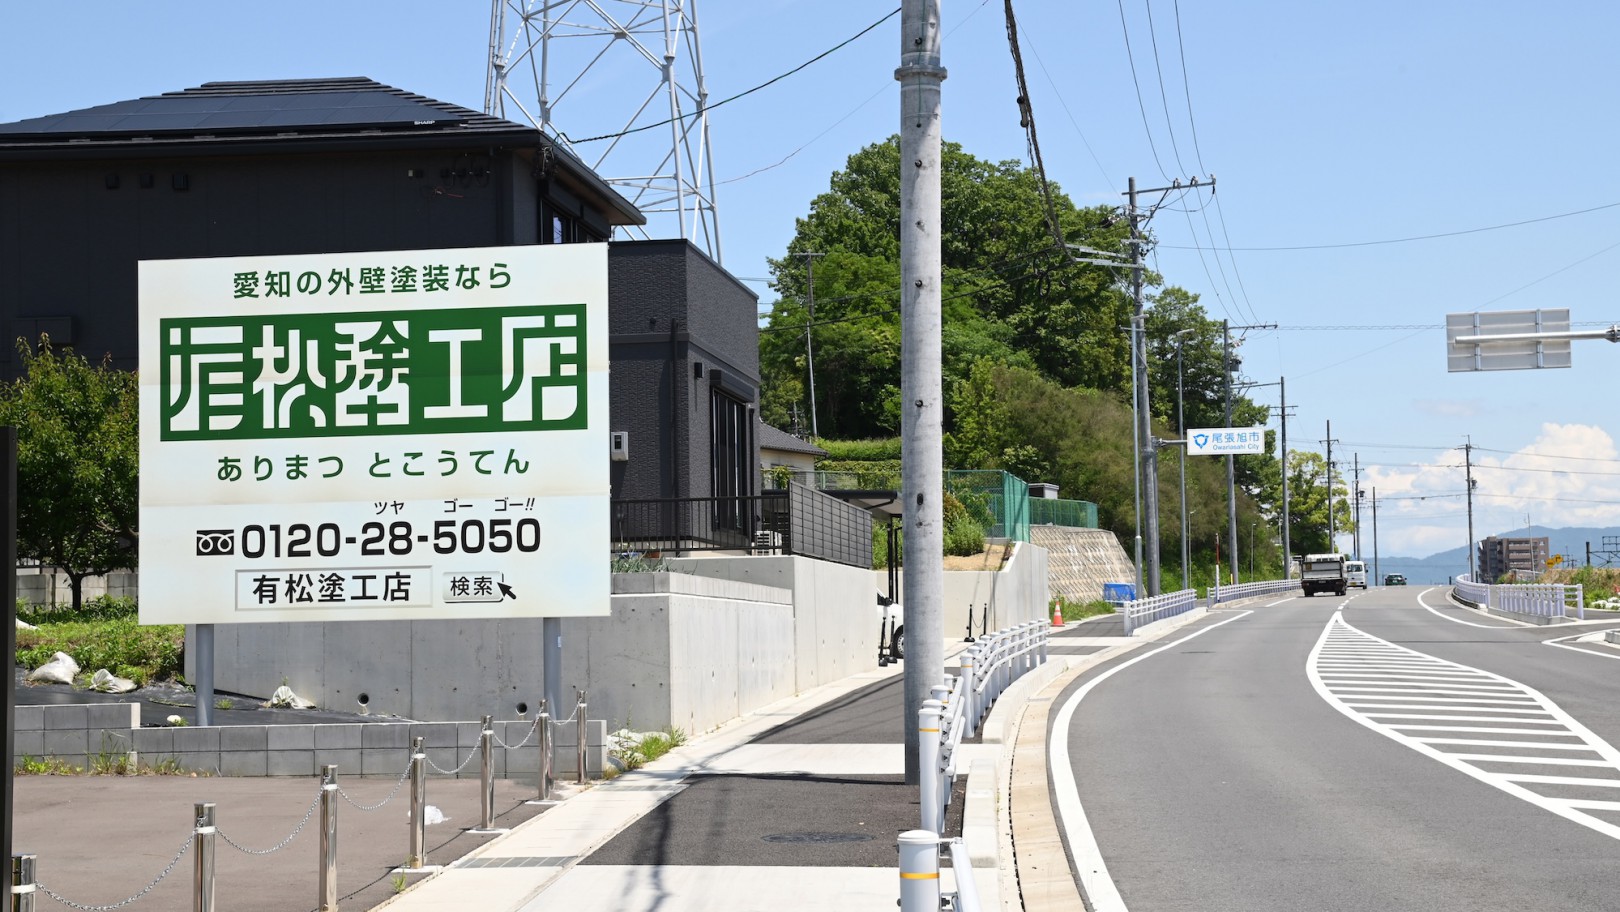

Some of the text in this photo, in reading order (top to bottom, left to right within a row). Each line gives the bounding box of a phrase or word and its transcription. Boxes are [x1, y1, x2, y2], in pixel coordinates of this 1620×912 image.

[232, 262, 512, 300] 愛知の外壁塗装なら
[168, 313, 579, 433] 有松塗工店
[1212, 431, 1259, 443] 尾張旭市
[216, 449, 531, 482] ありまつ とこうてん
[373, 499, 405, 515] ツヤ
[444, 497, 473, 514] ゴー
[240, 517, 542, 559] 0120-28-5050
[252, 571, 412, 604] 有松塗工店
[449, 574, 494, 597] 検索
